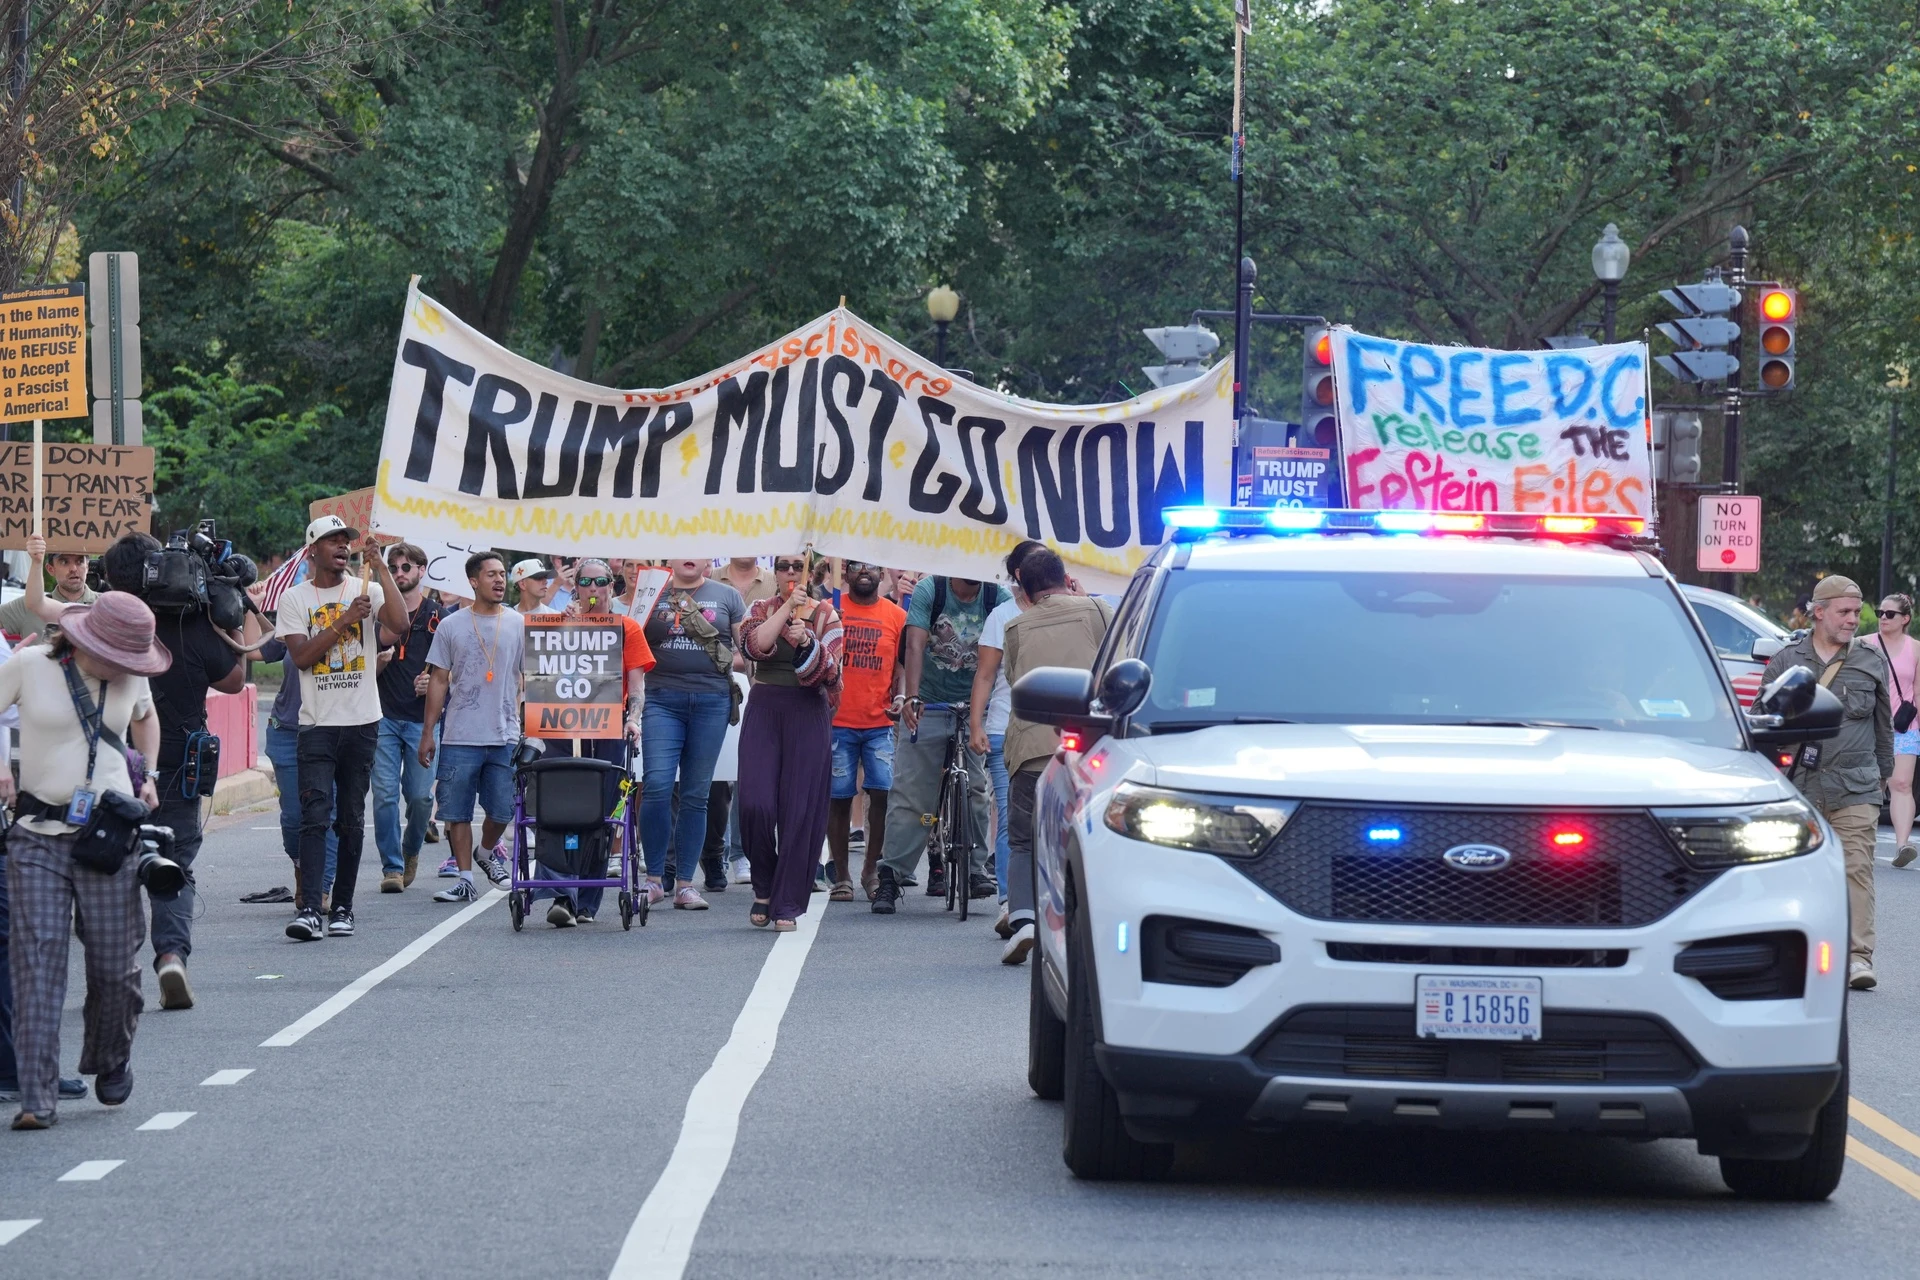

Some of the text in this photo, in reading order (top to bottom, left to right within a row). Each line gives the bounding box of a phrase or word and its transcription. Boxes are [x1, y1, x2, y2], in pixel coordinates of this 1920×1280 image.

[2, 287, 69, 300] RefuseFascism.org
[10, 309, 32, 322] the
[37, 306, 79, 319] Name
[9, 323, 82, 341] Humanity,
[0, 341, 76, 360] We REFUSE
[2, 360, 70, 379] to Accept
[4, 379, 69, 397] a Fascist
[1347, 335, 1541, 428] FREE
[4, 397, 69, 416] America!
[402, 338, 1204, 548] TRUMP MUST GO NOW
[1371, 411, 1630, 461] release THE
[48, 446, 133, 467] DON'T
[1257, 448, 1324, 457] RefuseFascism.org
[1256, 461, 1326, 478] TRUMP
[42, 472, 148, 494] TYRANTS
[1262, 480, 1318, 496] MUST
[1513, 458, 1644, 515] Files
[83, 498, 141, 516] FEAR
[1717, 503, 1742, 516] NO
[1713, 520, 1746, 531] TURN
[1704, 534, 1753, 546] ON RED
[530, 615, 614, 624] RefuseFascism.org
[530, 631, 618, 651] TRUMP
[844, 625, 882, 642] TRUMP
[845, 638, 877, 655] MUST
[539, 654, 608, 675] MUST
[852, 654, 883, 671] NOW!
[318, 681, 359, 691] NETWORK
[331, 673, 362, 681] VILLAGE
[556, 678, 592, 699] GO
[540, 708, 610, 729] NOW!
[1460, 850, 1496, 865] Ford
[1463, 994, 1530, 1025] 15856
